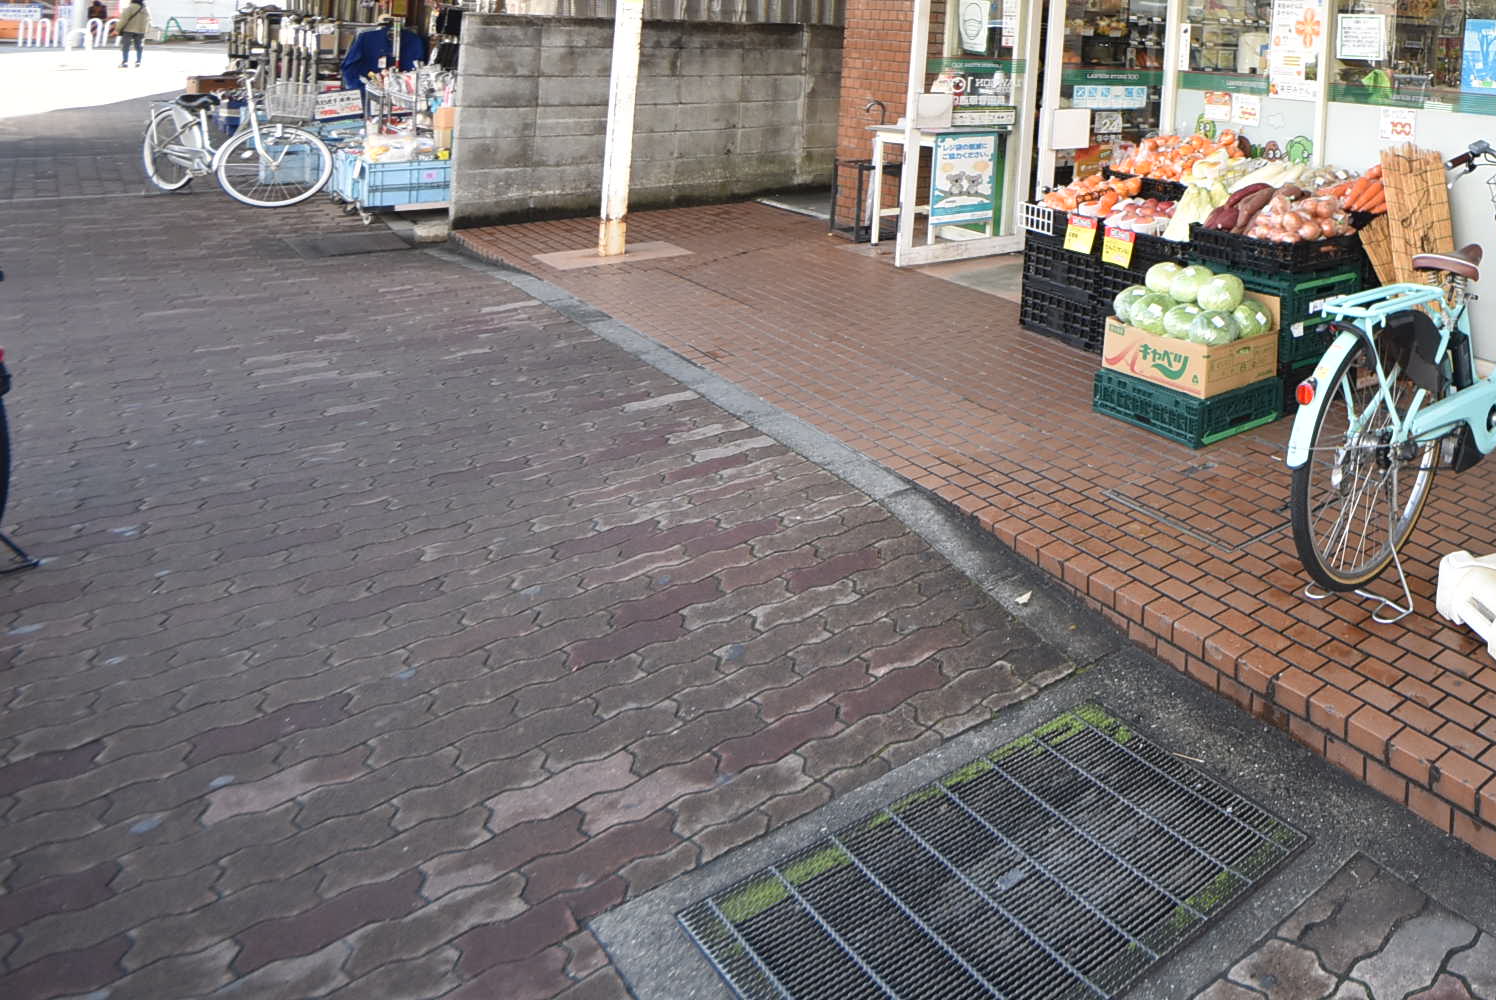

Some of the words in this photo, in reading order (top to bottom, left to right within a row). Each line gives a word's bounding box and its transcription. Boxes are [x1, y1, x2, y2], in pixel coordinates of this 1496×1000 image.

[1390, 121, 1412, 136] 100
[1138, 342, 1189, 380] キャベツ
